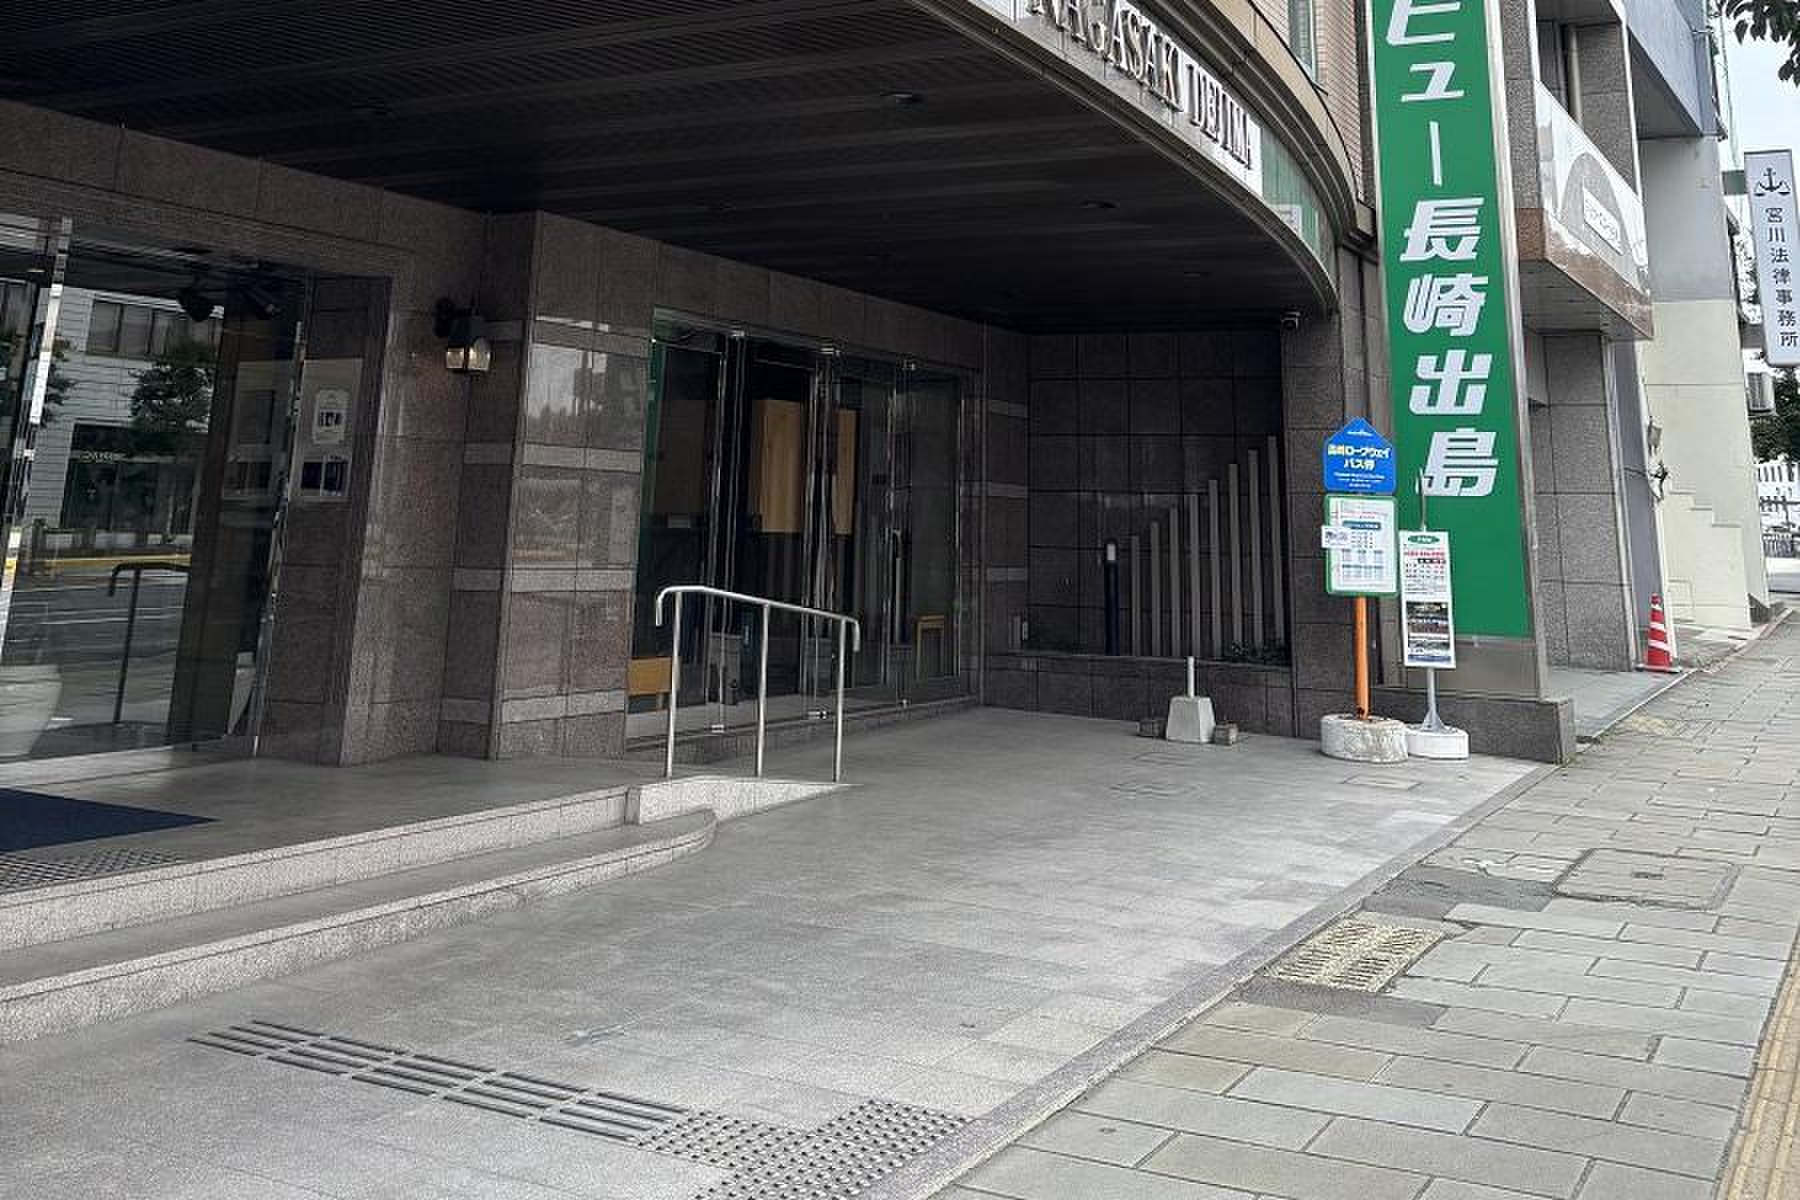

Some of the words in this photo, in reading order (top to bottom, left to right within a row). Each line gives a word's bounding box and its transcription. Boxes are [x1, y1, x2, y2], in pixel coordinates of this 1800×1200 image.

[1765, 207, 1798, 348] 宮川法律事務所
